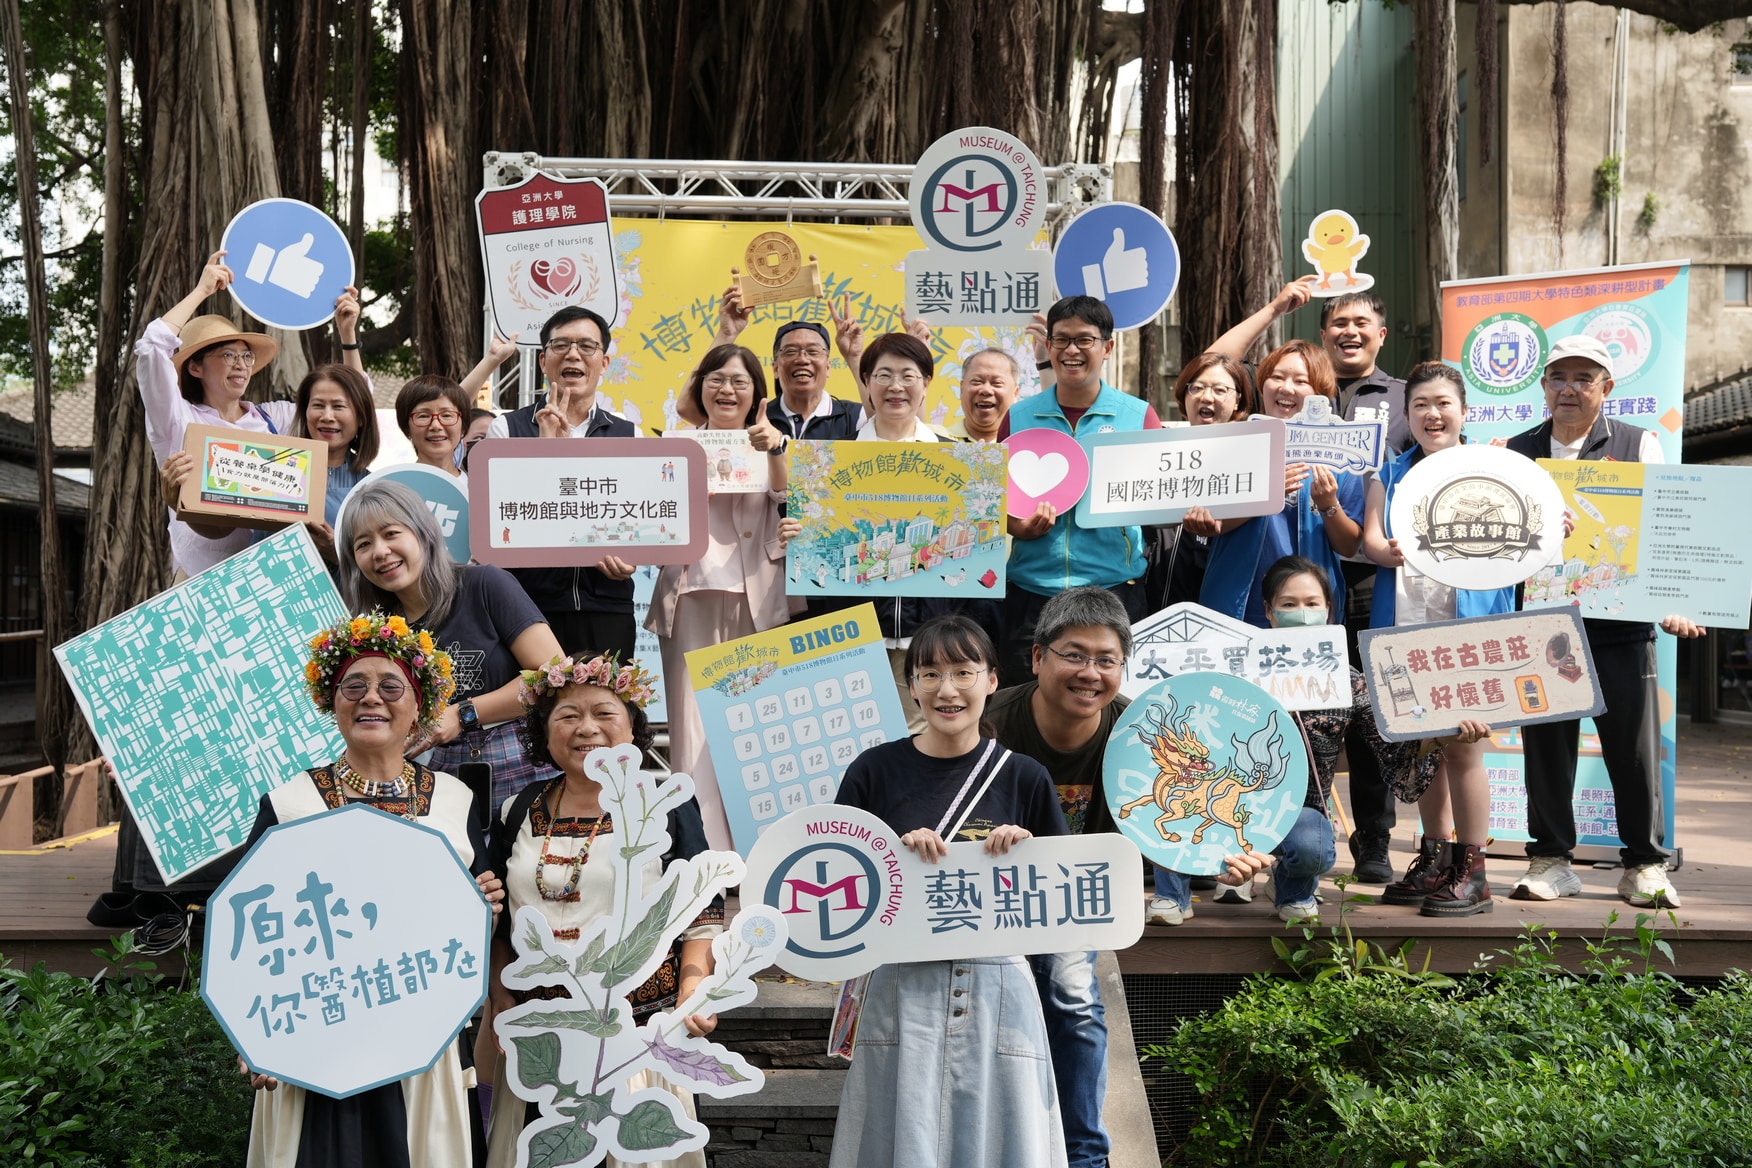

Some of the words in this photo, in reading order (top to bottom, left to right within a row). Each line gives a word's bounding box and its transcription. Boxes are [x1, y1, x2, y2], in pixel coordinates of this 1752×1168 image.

[959, 135, 1014, 155] MUSEUM
[1012, 152, 1026, 165] @
[521, 190, 564, 204] 亞洲大學
[1015, 163, 1037, 229] TAICHUNG
[511, 204, 577, 226] 護理學院
[505, 239, 540, 253] College
[543, 238, 554, 248] of
[557, 234, 594, 247] Nursing
[548, 300, 568, 308] SINCE
[915, 271, 1040, 314] 藝點通
[1456, 278, 1666, 308] 教育部第四期大學特色類深耕型計畫
[1486, 363, 1543, 394] UNIVERSITY
[1312, 429, 1370, 452] CENTER
[829, 450, 966, 490] 博物館歡城市
[1158, 449, 1203, 472] 518
[558, 476, 618, 496] 臺中市
[1106, 472, 1254, 504] 國際博物館日
[1551, 466, 1620, 487] 物館歡城市
[499, 500, 678, 521] 博物館與地方文化館
[1434, 523, 1523, 541] 產業故事館
[789, 620, 860, 655] BINGO
[701, 644, 780, 680] 博物館歡城市
[1406, 635, 1531, 675] 我在古農莊
[738, 711, 745, 723] 1
[762, 702, 778, 717] 25
[793, 694, 807, 708] 11
[825, 687, 833, 699] 3
[851, 677, 865, 691] 21
[1429, 678, 1506, 711] 好懷舊
[745, 740, 752, 753] 9
[771, 731, 786, 747] 19
[804, 724, 811, 737] 7
[829, 715, 844, 730] 17
[859, 707, 874, 722] 10
[752, 770, 760, 783] 5
[778, 761, 794, 776] 24
[808, 753, 823, 768] 12
[837, 745, 852, 760] 23
[757, 800, 772, 815] 15
[787, 791, 802, 806] 14
[819, 784, 828, 797] 6
[806, 820, 872, 843] MUSEUM
[871, 837, 888, 851] @
[879, 849, 903, 927] TAICHUNG
[924, 861, 1115, 934] 藝點通
[229, 871, 378, 976] 原來，
[246, 938, 478, 1038] 你醫植都在
